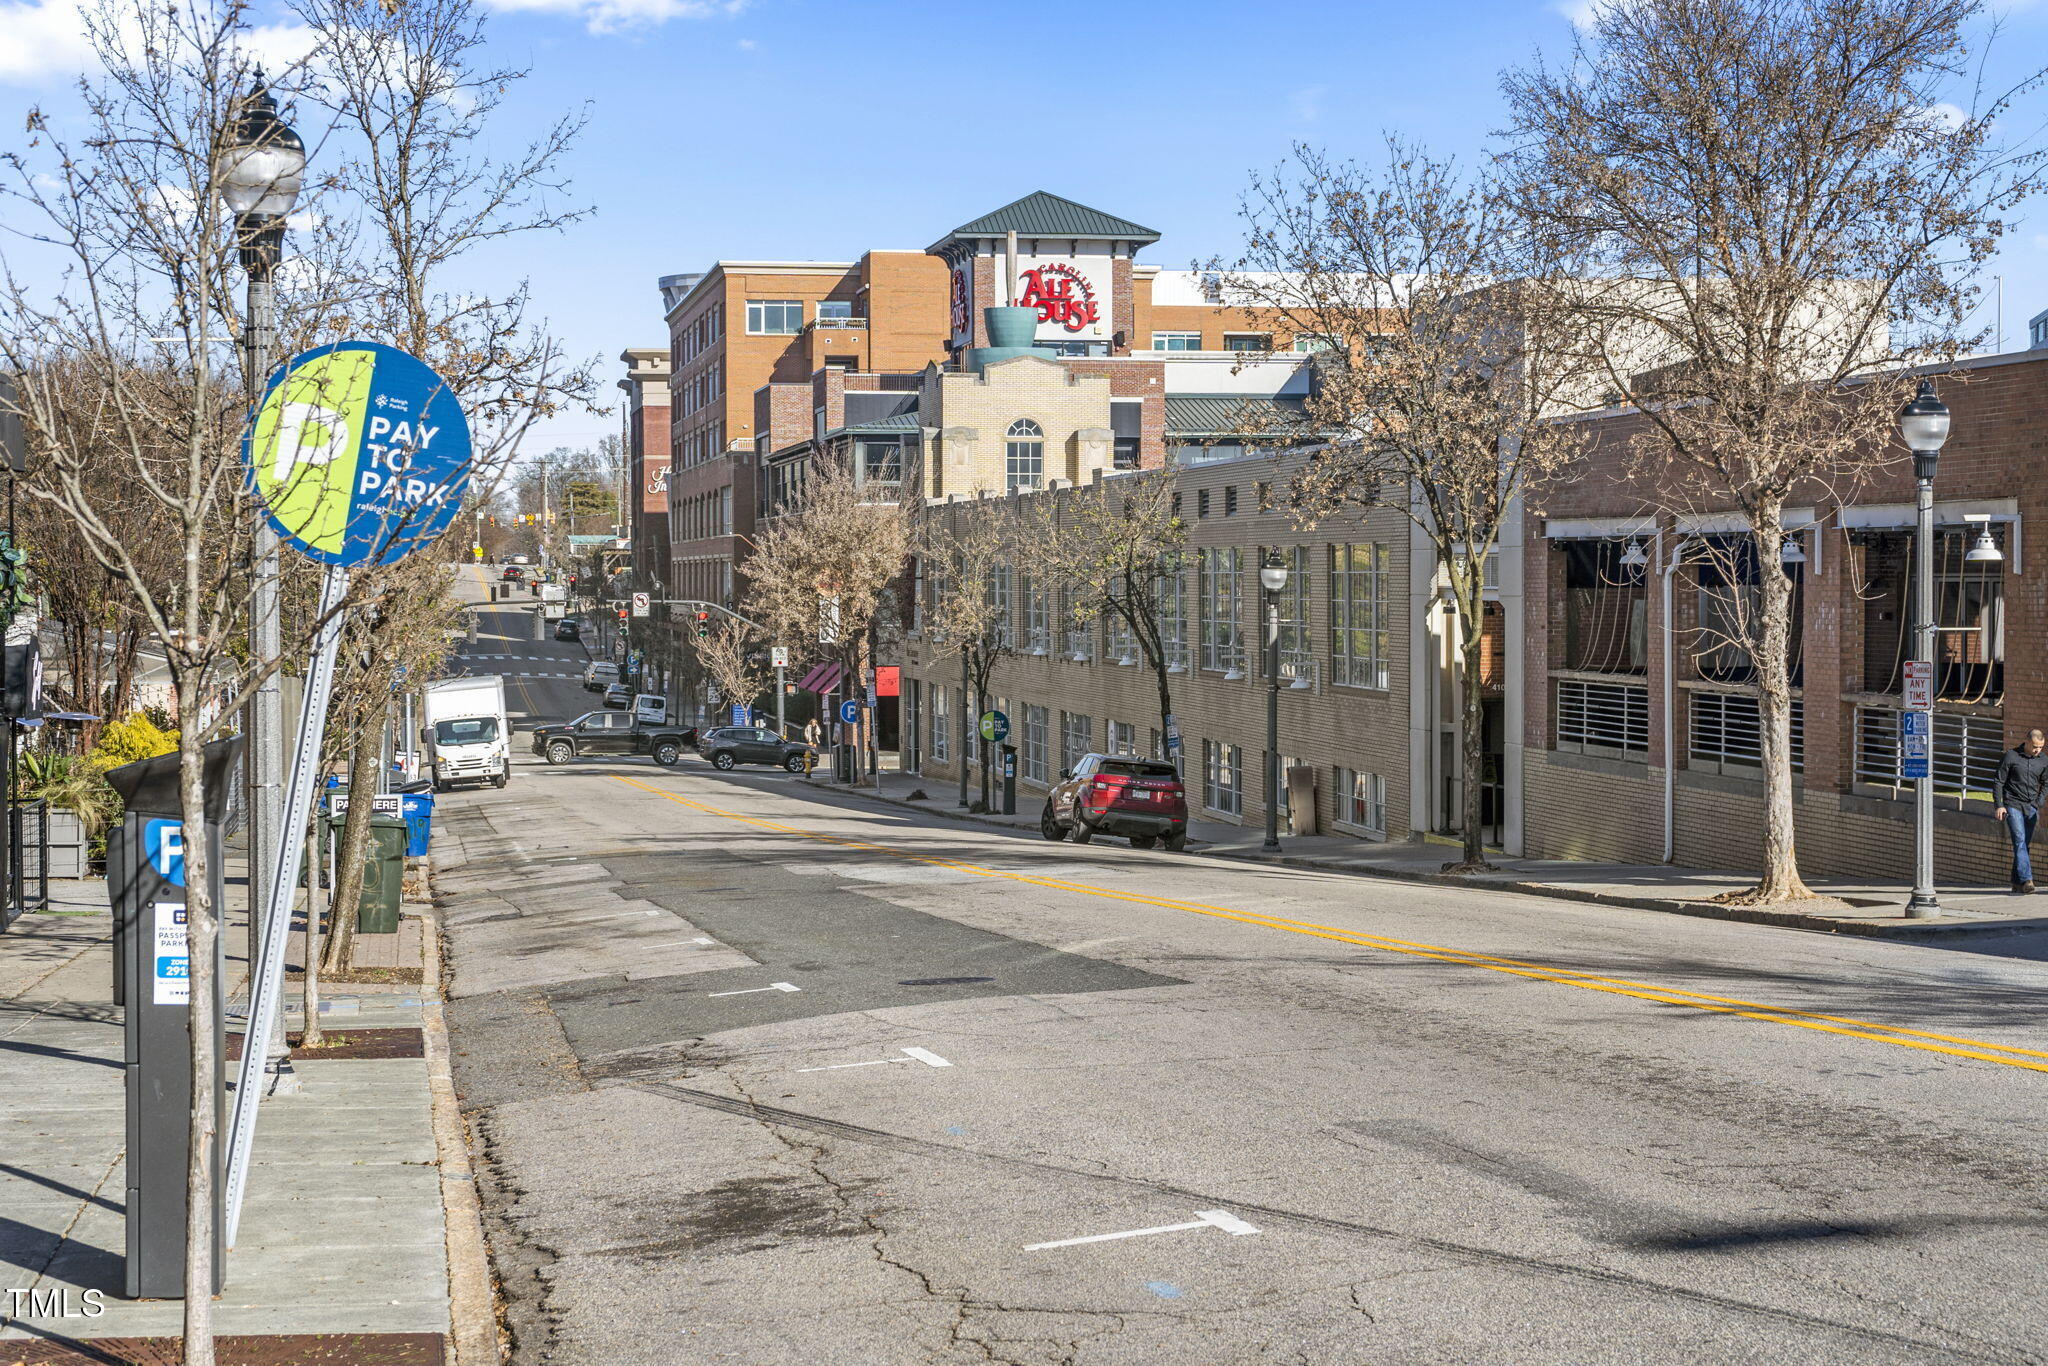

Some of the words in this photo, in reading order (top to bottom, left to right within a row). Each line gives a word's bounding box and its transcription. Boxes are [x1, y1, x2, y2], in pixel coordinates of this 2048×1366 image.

[1019, 269, 1075, 300] ALE
[1038, 262, 1096, 300] CAROLINA
[389, 397, 409, 407] Raleigh
[389, 402, 409, 412] Parking
[368, 416, 440, 449] PAY
[273, 402, 350, 481] P
[367, 443, 412, 472] TO
[360, 471, 450, 509] PARK
[1909, 679, 1925, 688] ANY
[708, 694, 719, 702] 25
[1909, 691, 1926, 700] TIME
[847, 705, 856, 718] P
[982, 720, 992, 732] P
[1906, 717, 1912, 731] 2
[337, 801, 349, 809] PA
[165, 966, 189, 976] 291
